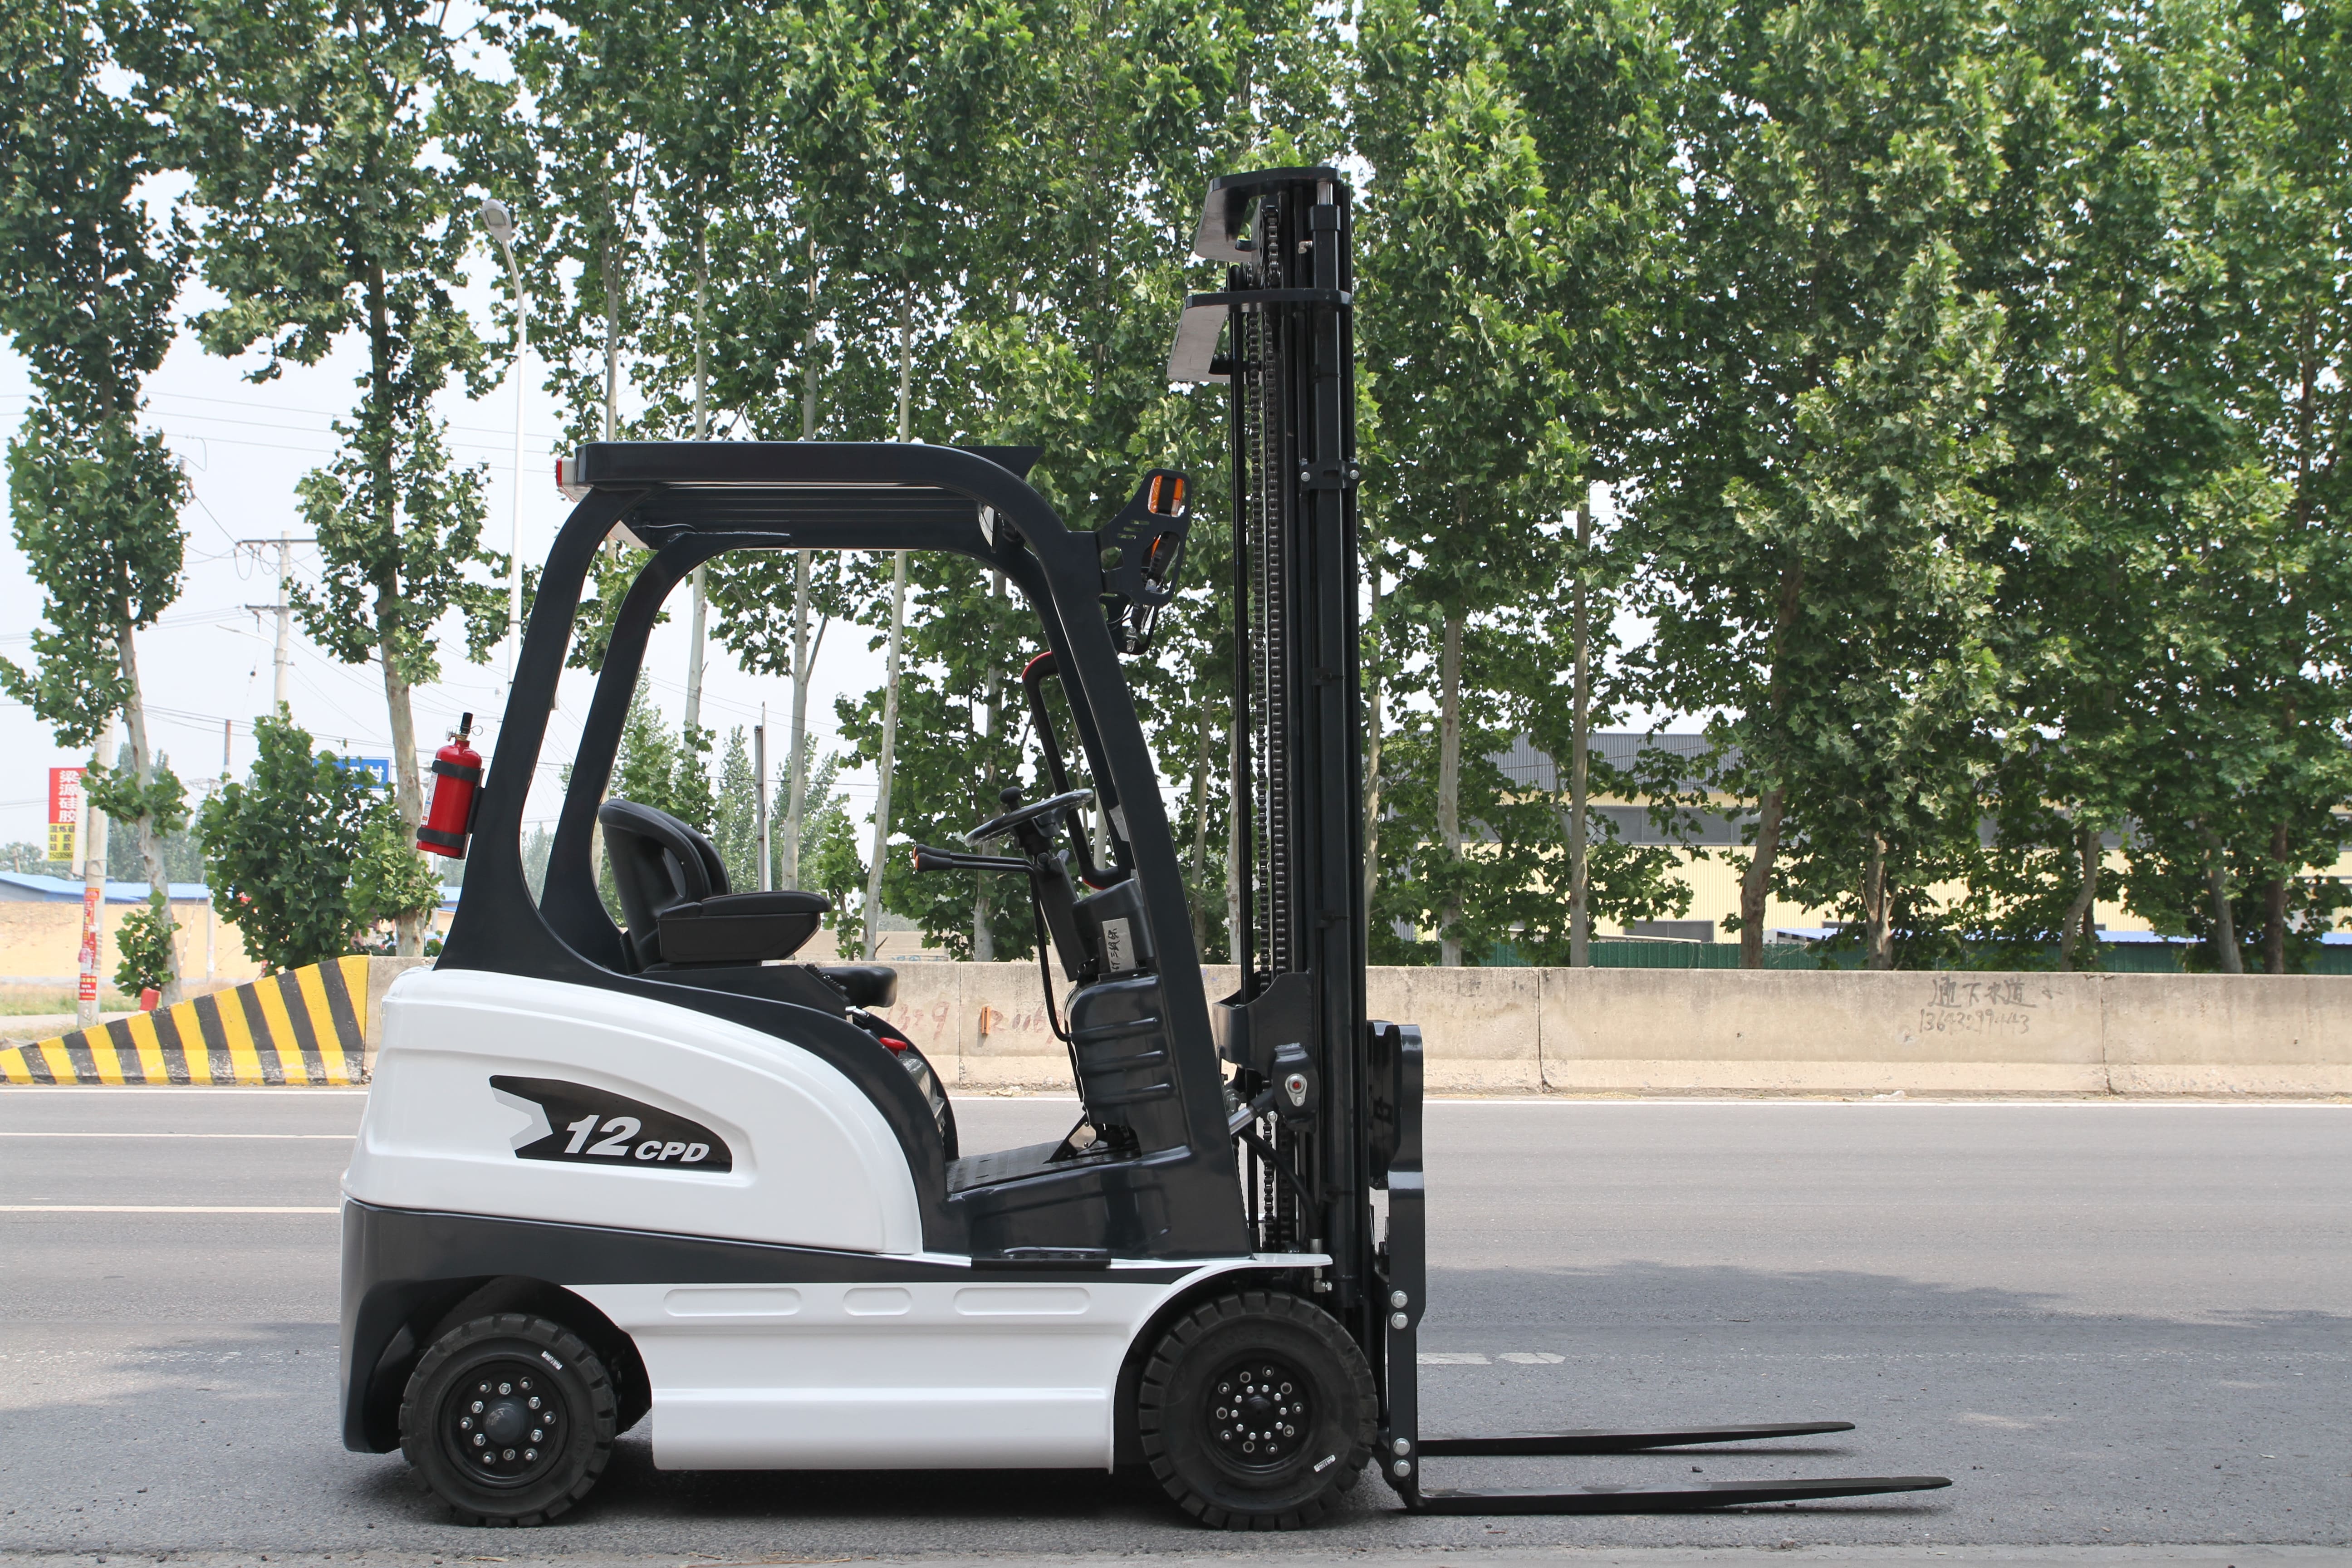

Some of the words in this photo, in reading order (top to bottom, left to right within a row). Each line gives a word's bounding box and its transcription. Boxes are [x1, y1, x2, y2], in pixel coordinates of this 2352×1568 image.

[58, 770, 79, 823] 梁源硅胶
[564, 1114, 642, 1156] 12
[635, 1140, 710, 1162] CPD
